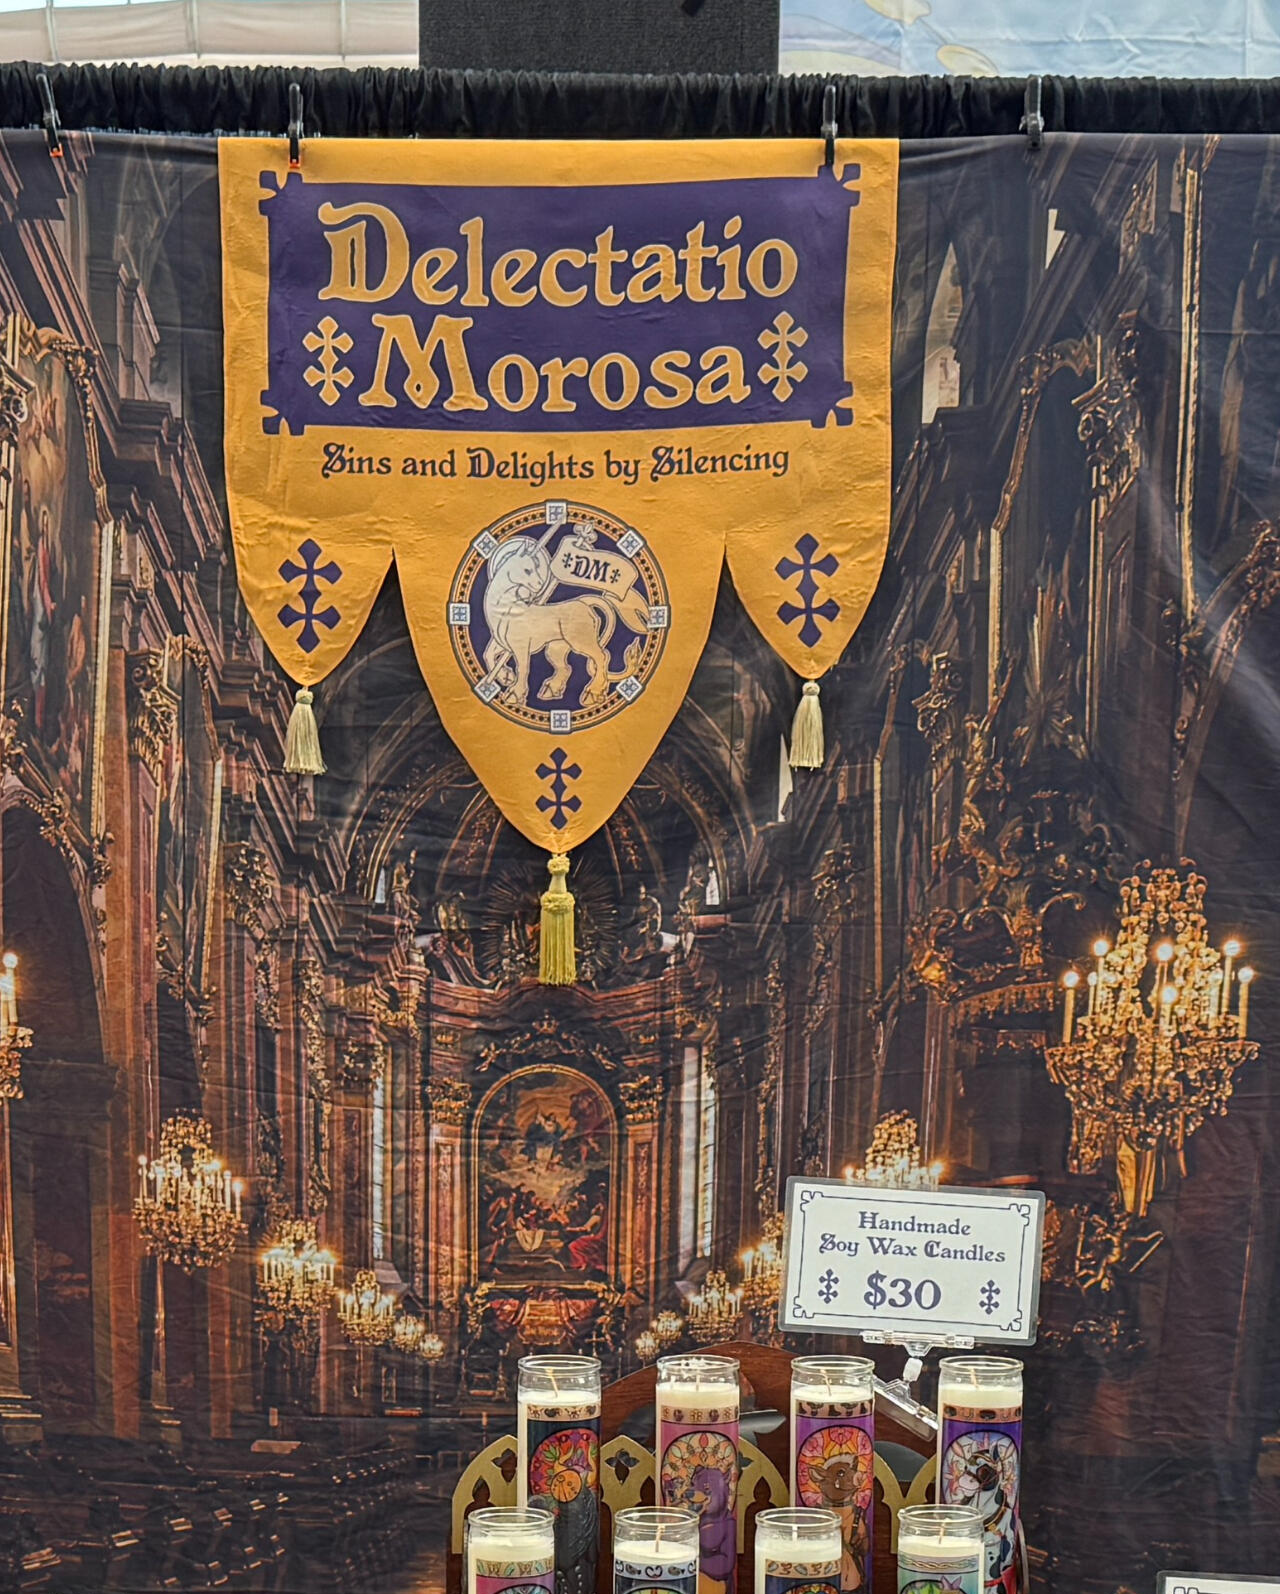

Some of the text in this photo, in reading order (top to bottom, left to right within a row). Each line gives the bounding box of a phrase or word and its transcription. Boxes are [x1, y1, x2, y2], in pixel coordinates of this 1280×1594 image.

[318, 201, 798, 308] Delectatio
[357, 313, 752, 413] Morosa
[322, 442, 790, 487] Sins and Delights by Silencing
[573, 555, 610, 586] DM
[858, 1211, 971, 1236] Handmade
[819, 1232, 1006, 1263] Soy Wax Candles
[863, 1270, 942, 1310] $30
